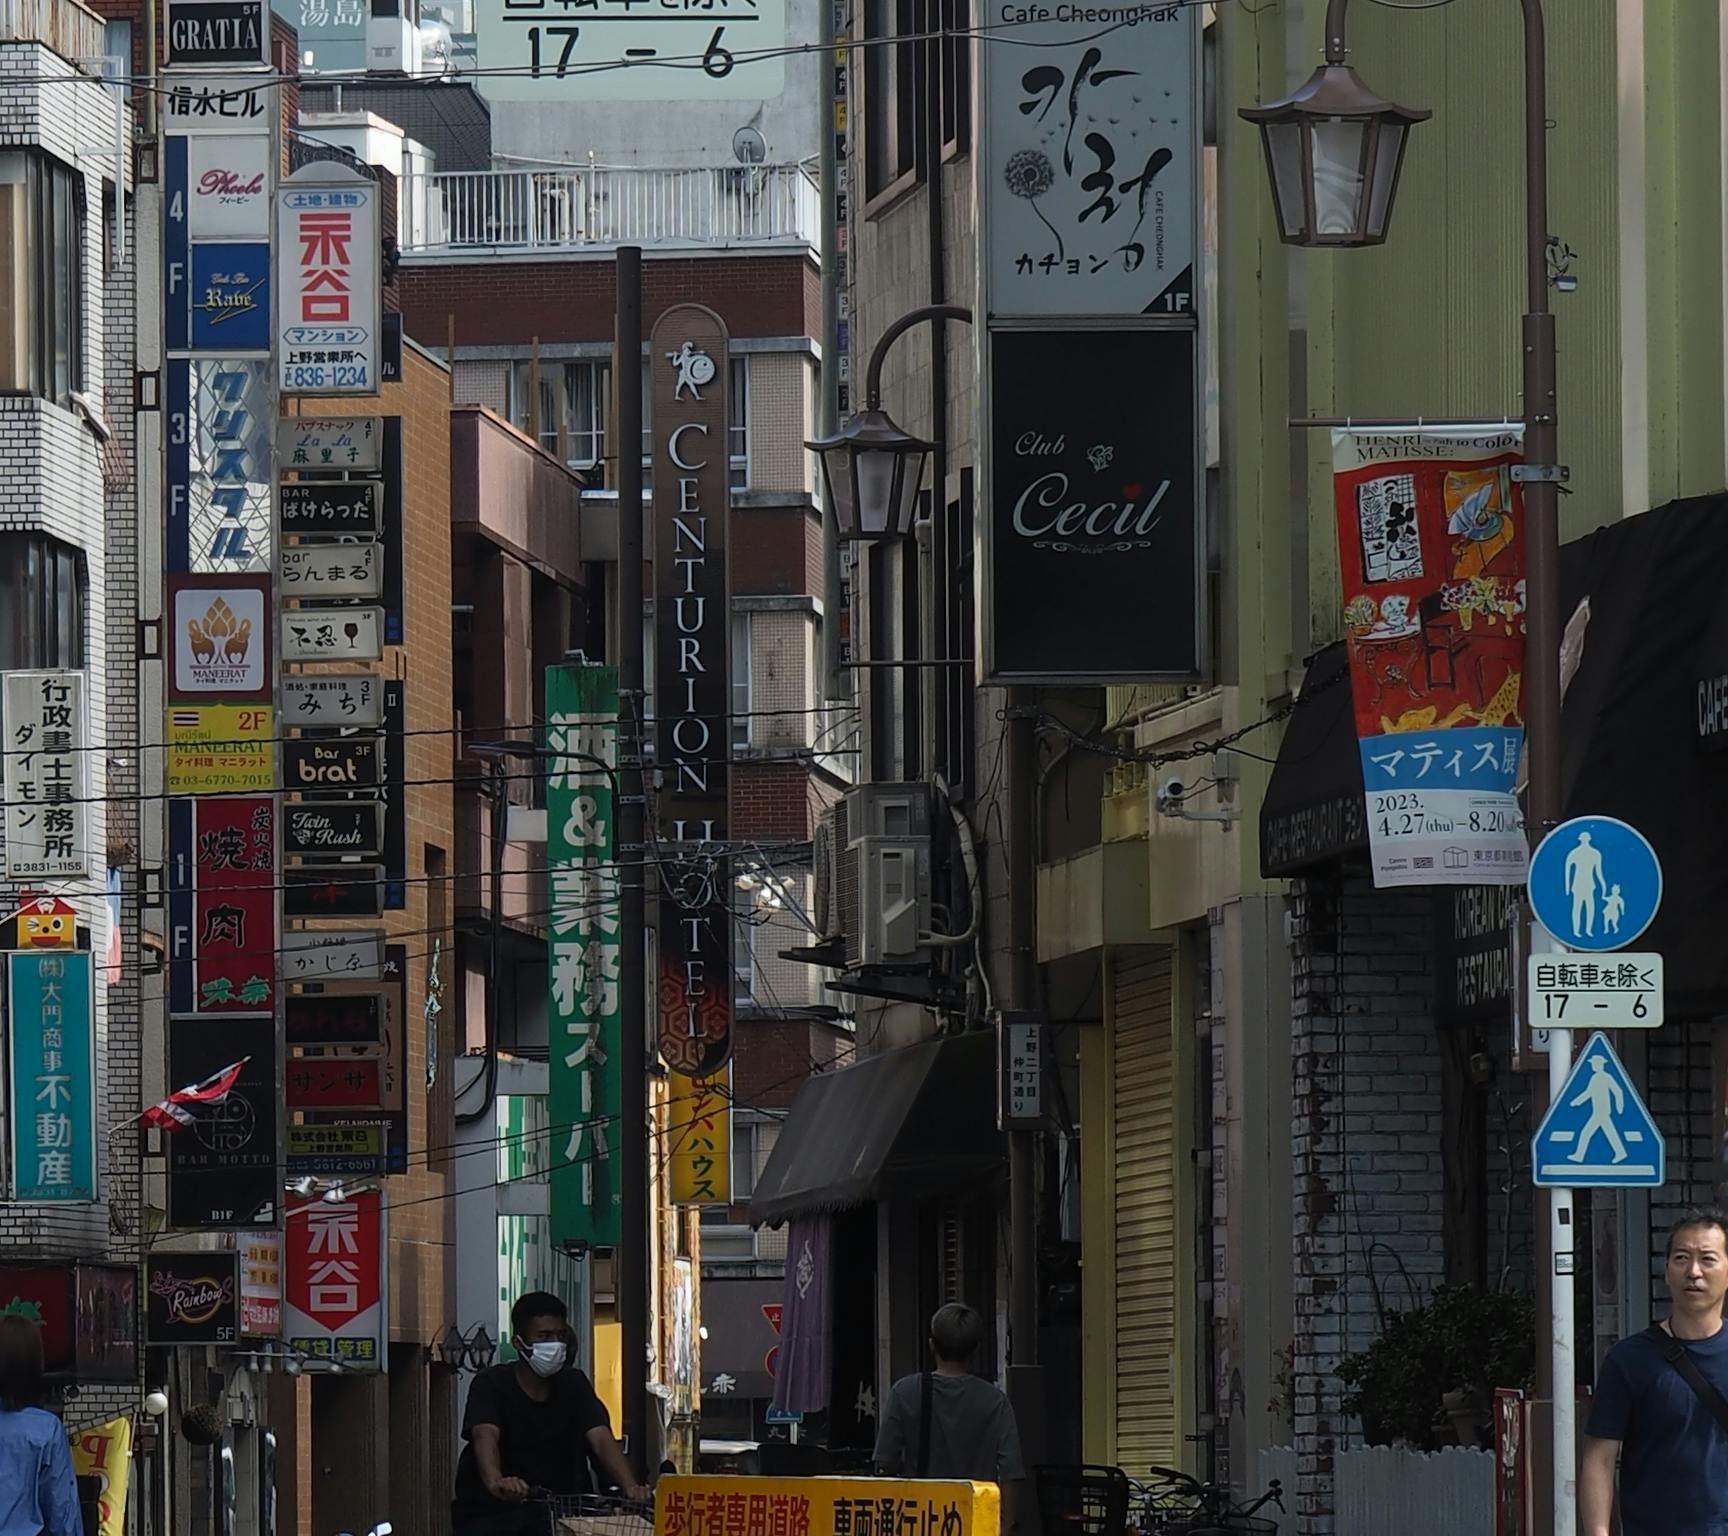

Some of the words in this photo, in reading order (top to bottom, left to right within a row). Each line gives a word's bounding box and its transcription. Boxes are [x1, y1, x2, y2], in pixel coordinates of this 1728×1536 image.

[243, 5, 260, 17] 5F
[1001, 3, 1049, 23] Cafe
[1056, 3, 1180, 27] Cheonghak
[172, 19, 259, 52] GRATIA
[527, 26, 580, 80] 17
[702, 26, 735, 80] 6
[168, 85, 266, 119] 信水ビル
[219, 196, 251, 205] フィービー
[293, 194, 359, 207] 土地・建物
[1155, 190, 1164, 220] CAFE
[1155, 222, 1164, 272] CHEONGHAK
[1015, 252, 1109, 276] カチョン
[1165, 291, 1190, 312] 1F
[292, 330, 360, 341] マンション
[286, 350, 368, 365] 上野営業所へ
[294, 366, 368, 387] 836-1234
[1015, 430, 1065, 456] Club
[1355, 434, 1423, 448] HENRI
[292, 447, 360, 465] 麻里子
[1357, 446, 1455, 463] MATISSE:
[282, 488, 311, 499] BAR
[283, 500, 370, 519] ばけらった
[1011, 471, 1172, 538] Cecil
[282, 551, 311, 565] bar
[282, 566, 370, 582] らんまる
[667, 423, 711, 794] CENTURION
[289, 625, 338, 649] 不忍
[193, 669, 248, 678] MANEERAT
[298, 693, 358, 715] みち
[238, 711, 267, 731] 2F
[174, 741, 264, 754] MANEERAT
[314, 746, 340, 760] Bar
[354, 745, 372, 757] 3F
[1369, 736, 1519, 780] マティス展
[41, 678, 76, 860] 行政書士事務所
[175, 757, 214, 768] タイ料理
[218, 757, 267, 768] マニラット
[298, 758, 358, 783] brat
[14, 723, 39, 830] ダイモン
[182, 775, 272, 785] 03-6770-7015
[1375, 792, 1425, 814] 2023.
[291, 812, 331, 830] Twin
[251, 806, 272, 872] 炭火焼
[314, 828, 363, 846] Rush
[22, 862, 83, 873] 3831-1155
[200, 825, 249, 950] 焼肉
[1454, 884, 1495, 941] KOREAN
[673, 820, 715, 1040] HOTEL
[548, 712, 619, 1206] 酒&業務スーパー
[1456, 947, 1516, 1008] RESTAURA
[1537, 963, 1655, 989] 自転車を除く
[1544, 994, 1569, 1019] 17
[1633, 993, 1648, 1019] 6
[1026, 1027, 1037, 1098] 上野二丁目
[1014, 1056, 1024, 1112] 仲町通り
[219, 1154, 272, 1166] MOTTO
[210, 1208, 235, 1222] B1F
[215, 1327, 235, 1341] 5F
[335, 1339, 375, 1357] 管理
